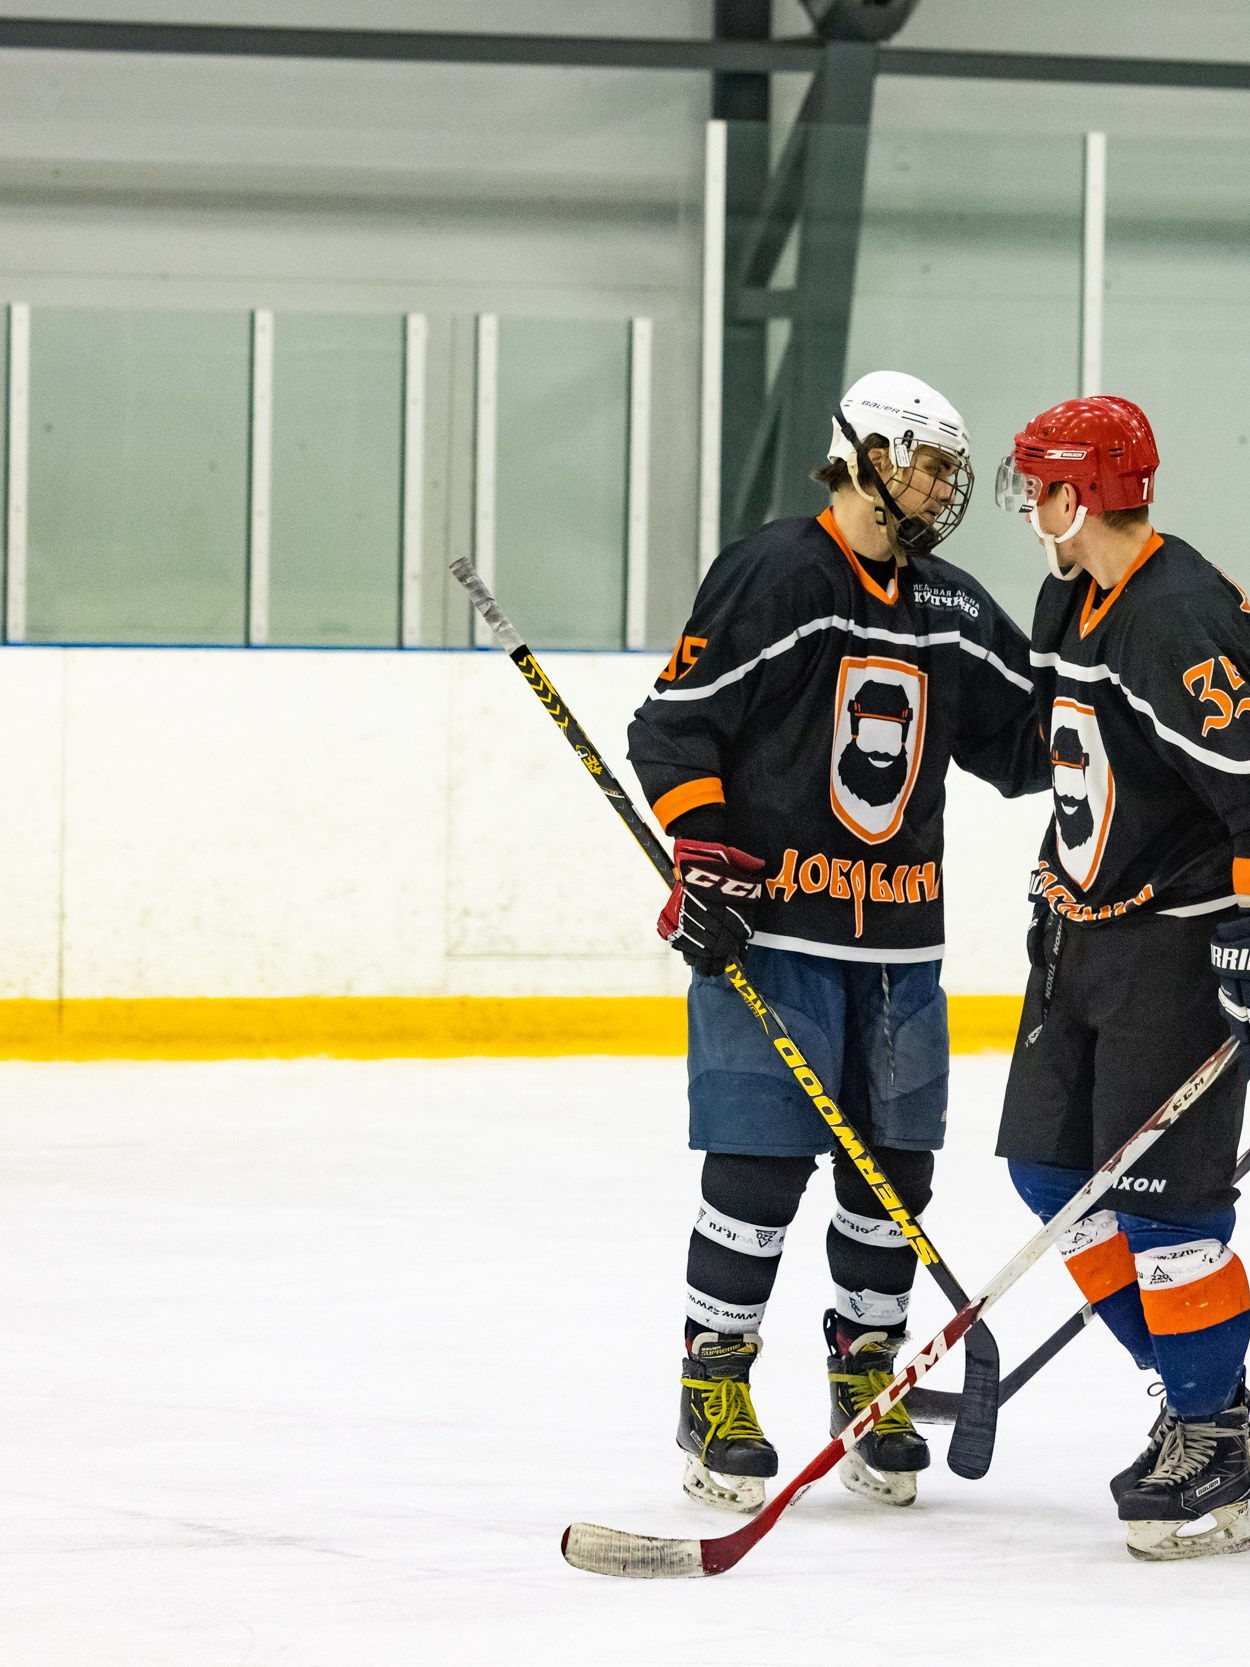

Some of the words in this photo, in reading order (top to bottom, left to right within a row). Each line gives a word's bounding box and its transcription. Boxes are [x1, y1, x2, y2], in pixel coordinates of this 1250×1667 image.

[861, 400, 901, 414] BAUER
[913, 591, 979, 618] КУПЧИНО
[766, 848, 944, 938] ДОБРЫН
[1172, 1076, 1205, 1112] CCM
[773, 1037, 940, 1266] SHERWOOD
[1150, 1273, 1169, 1282] 220
[841, 1331, 948, 1453] CCM
